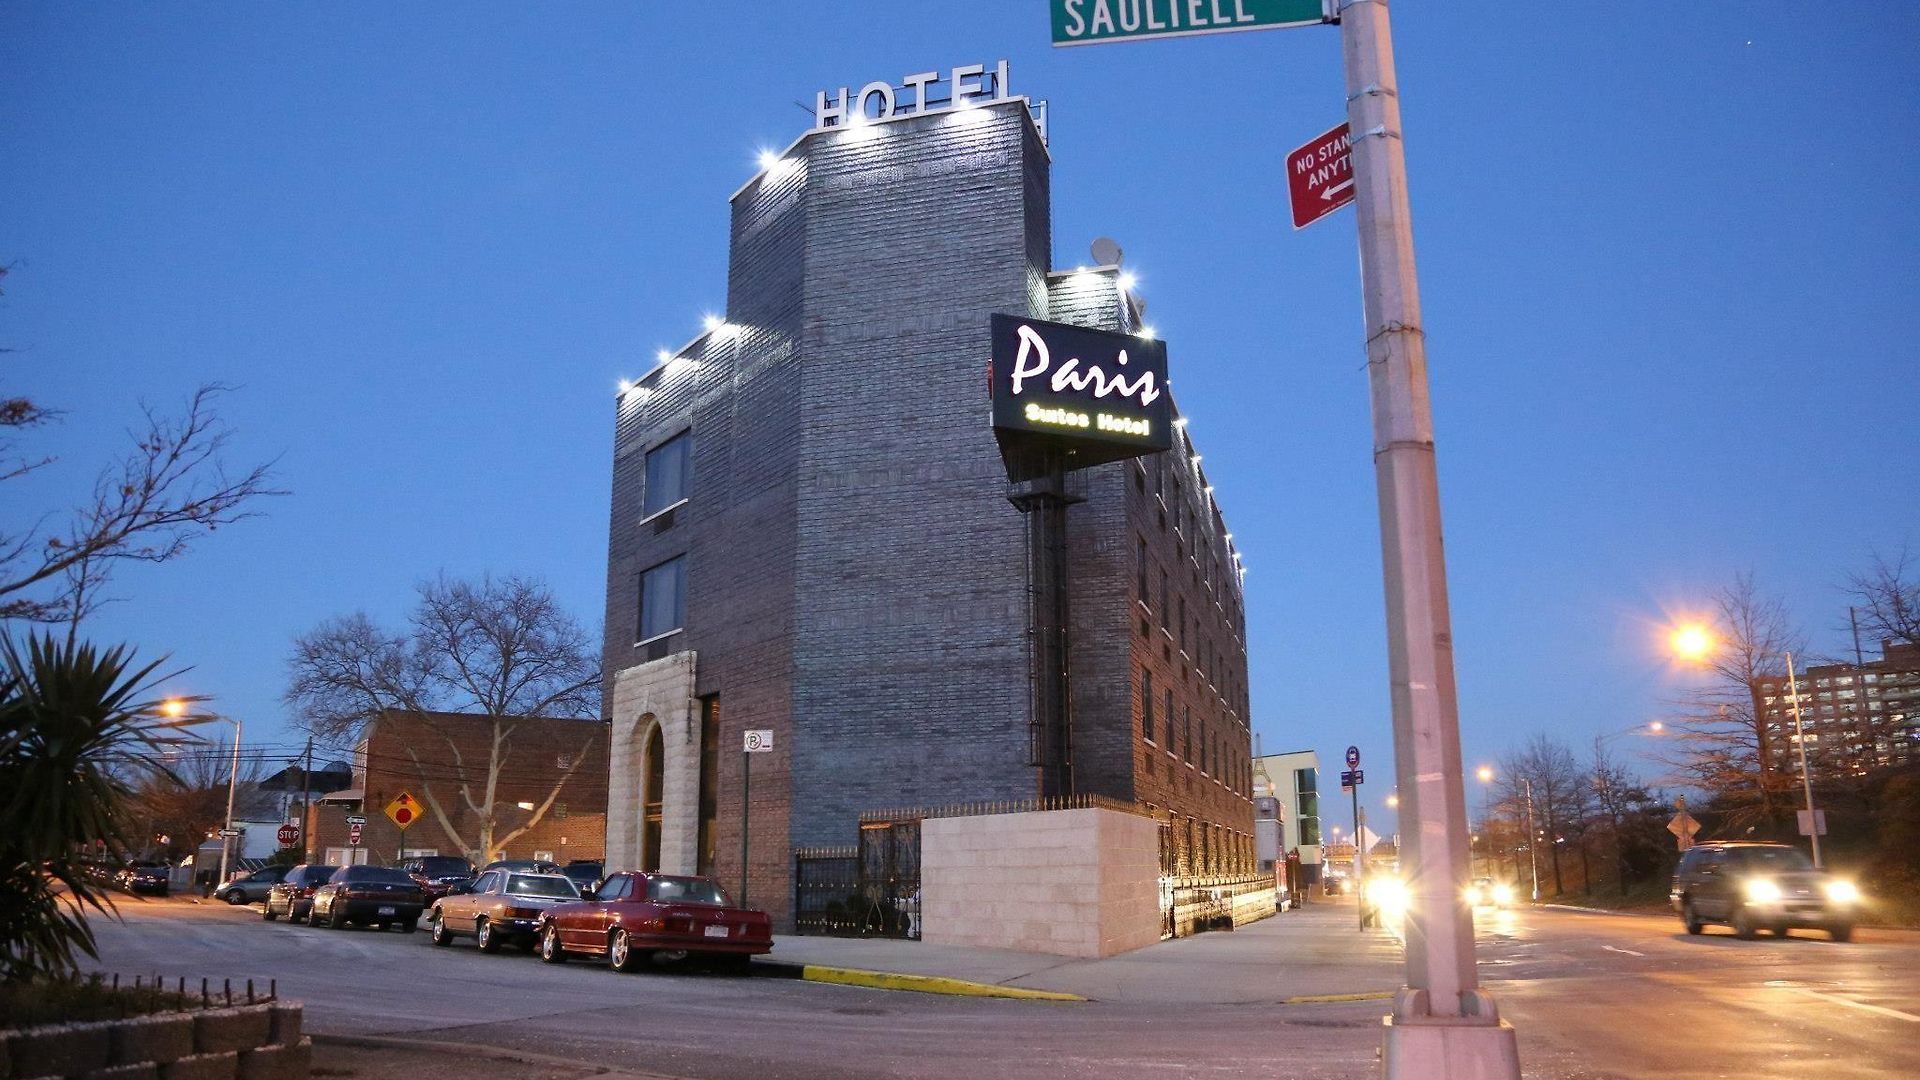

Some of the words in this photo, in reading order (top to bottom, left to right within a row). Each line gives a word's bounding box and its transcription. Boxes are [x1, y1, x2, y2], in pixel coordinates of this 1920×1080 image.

[816, 59, 1009, 130] HOTEL
[1296, 154, 1315, 175] NO
[1011, 325, 1160, 406] Paris
[1097, 413, 1150, 436] Hotel
